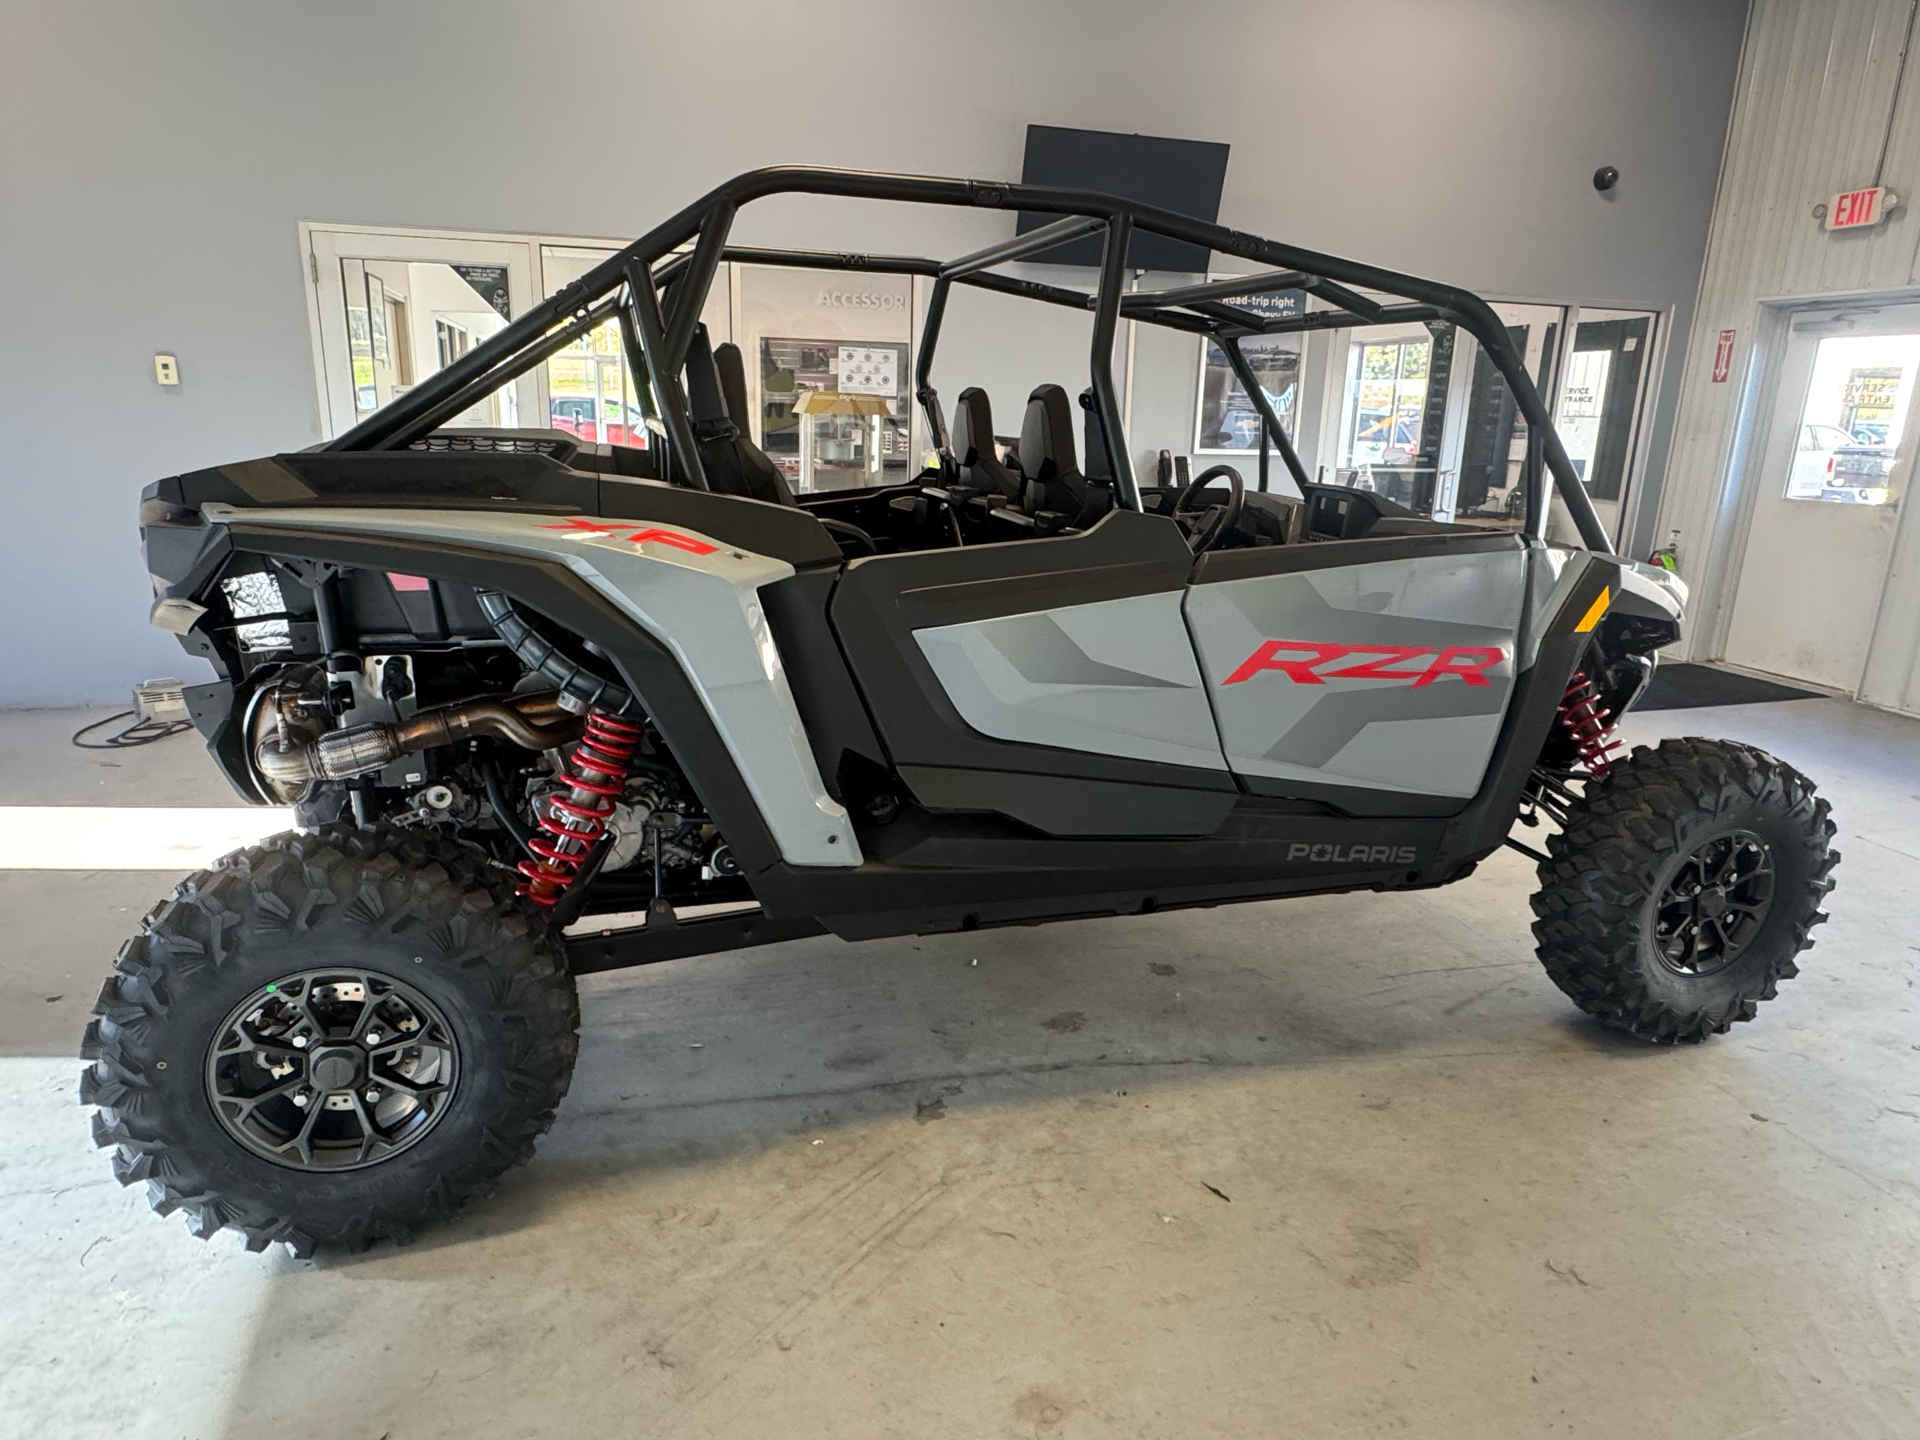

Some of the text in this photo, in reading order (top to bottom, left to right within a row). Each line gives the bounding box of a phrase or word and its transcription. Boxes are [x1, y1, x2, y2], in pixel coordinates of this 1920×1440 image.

[1834, 190, 1877, 226] EXIT
[1222, 295, 1295, 309] Road-trip right
[531, 518, 721, 556] XP
[1221, 640, 1507, 690] RZR
[1287, 843, 1416, 864] POLARIS
